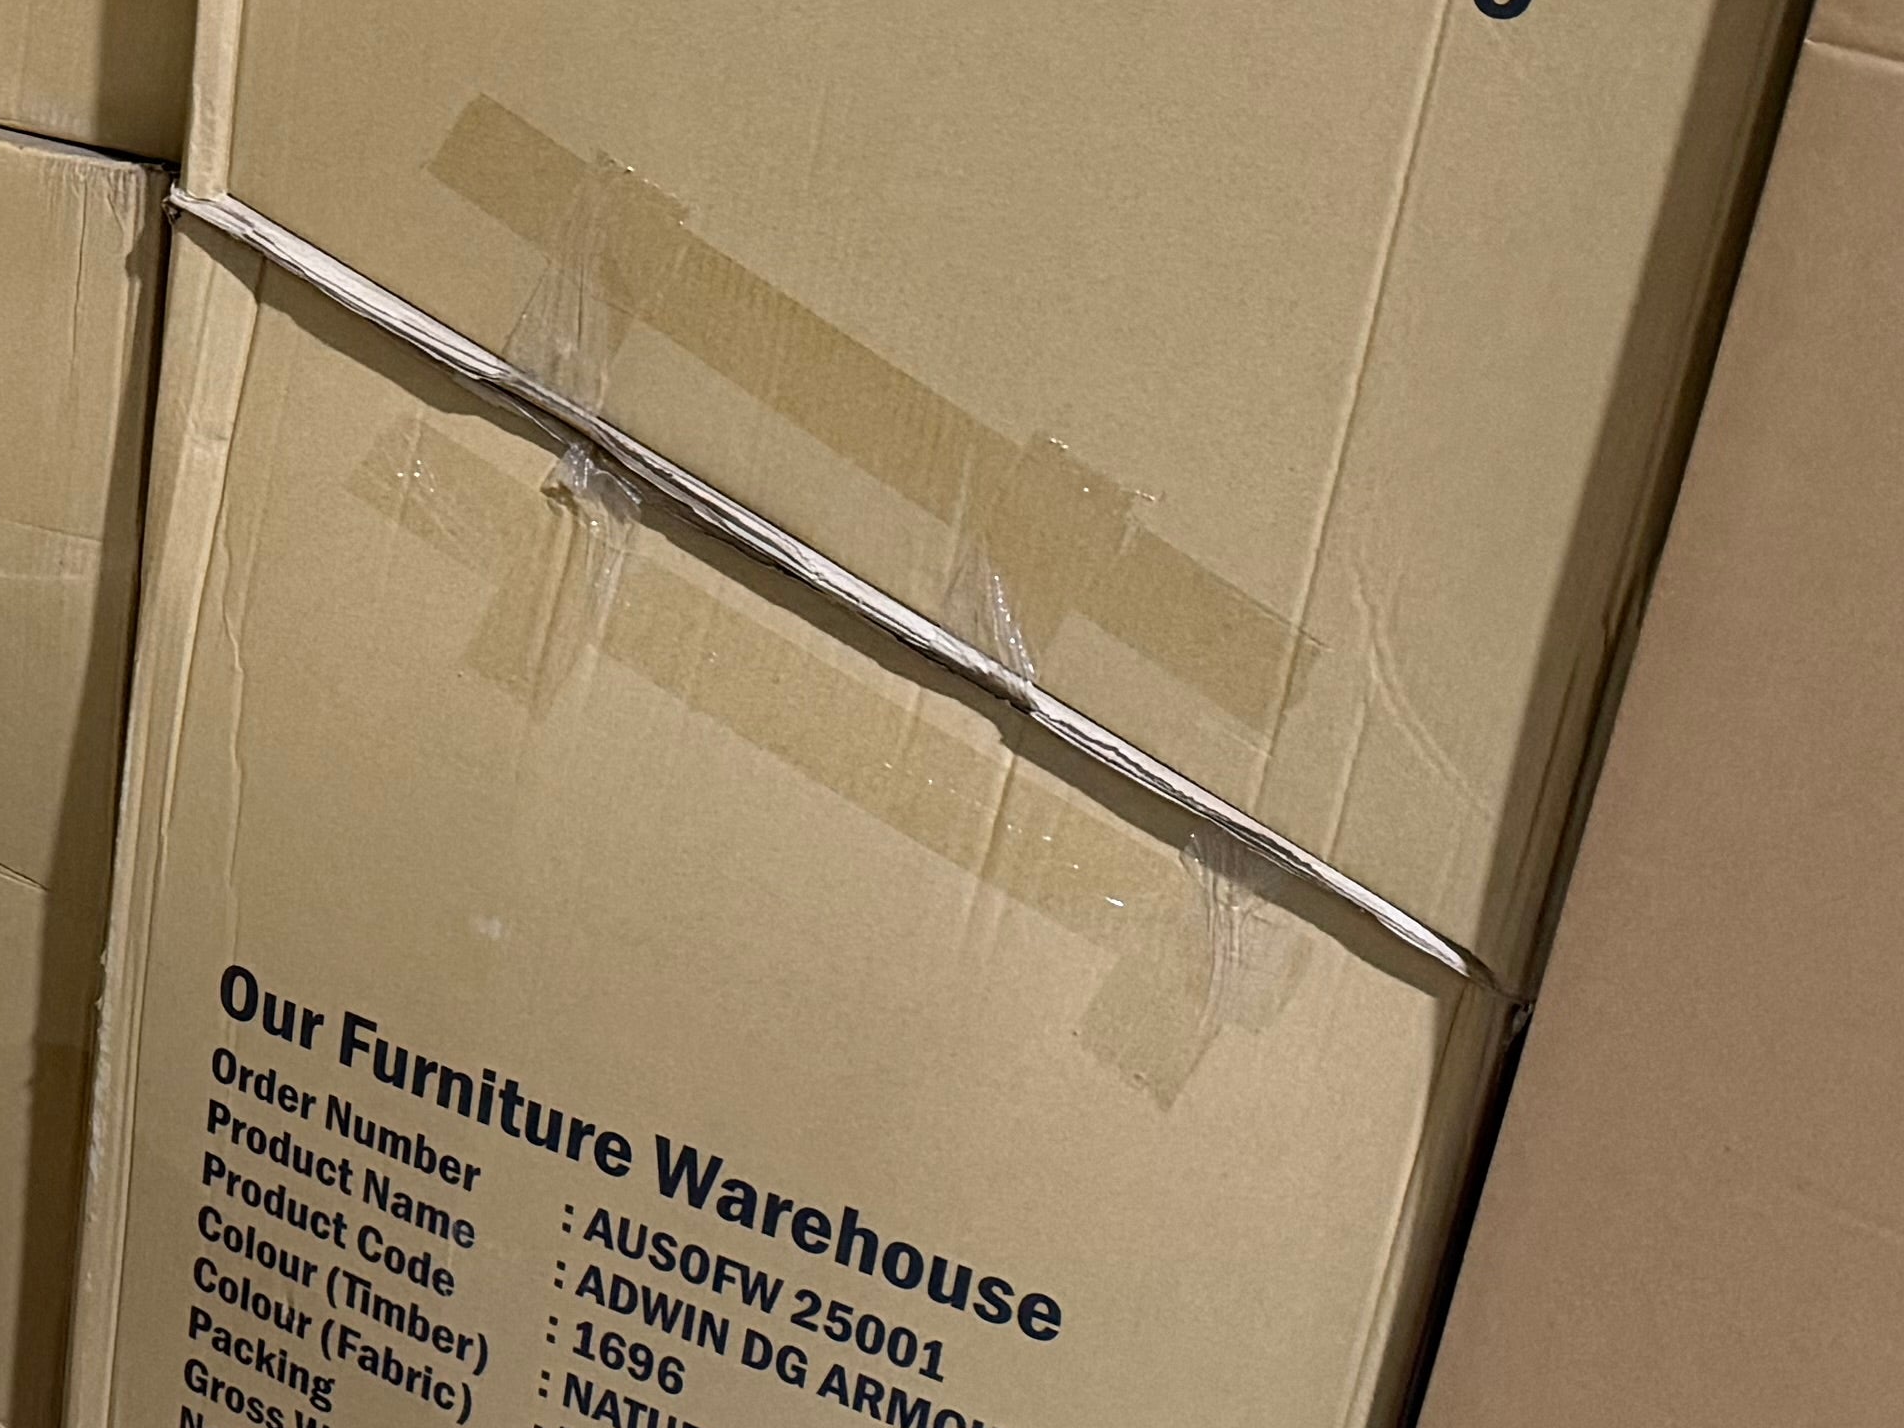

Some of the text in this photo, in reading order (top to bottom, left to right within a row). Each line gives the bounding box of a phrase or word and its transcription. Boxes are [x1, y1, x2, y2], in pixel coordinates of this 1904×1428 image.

[206, 1098, 354, 1196] Product
[362, 1168, 475, 1249] Name
[574, 1264, 730, 1356] ADWIN
[740, 1328, 808, 1389] DG
[219, 964, 1062, 1342] Our Furniture Warehouse
[188, 1305, 336, 1414] Packing
